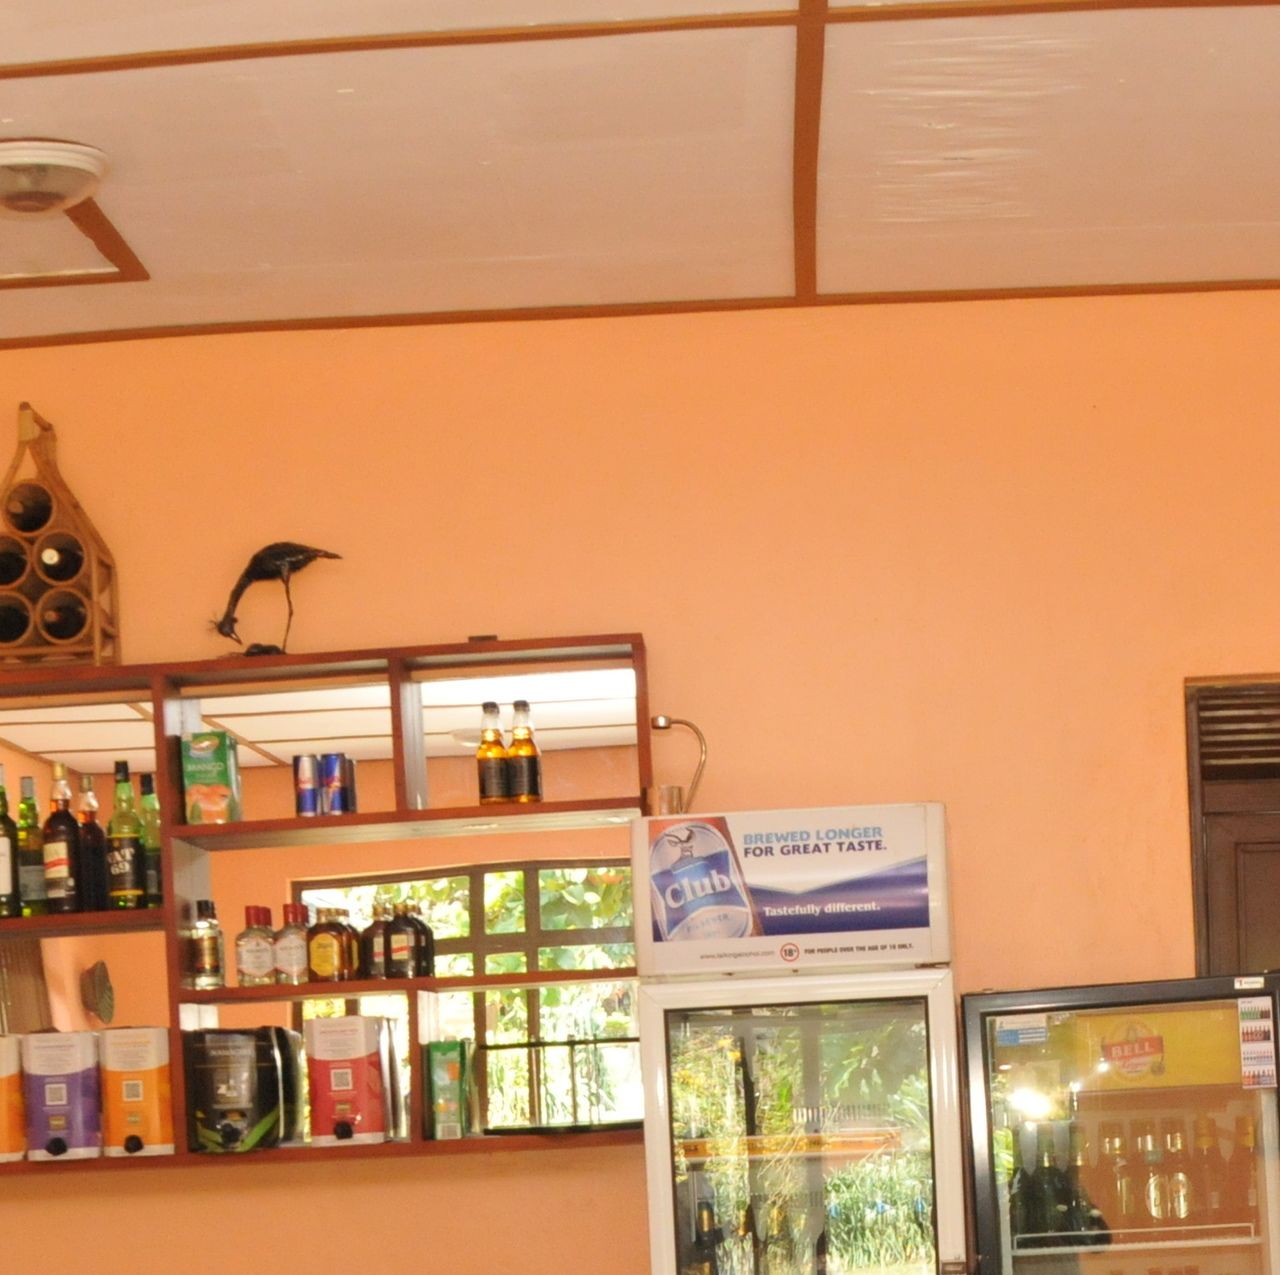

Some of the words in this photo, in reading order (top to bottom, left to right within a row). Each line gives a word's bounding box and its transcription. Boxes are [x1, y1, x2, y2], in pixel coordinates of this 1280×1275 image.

[744, 831, 810, 845] BREWED
[816, 827, 882, 841] LONGER
[744, 846, 774, 858] FOR
[780, 843, 831, 856] GREAT
[836, 840, 887, 852] TASTE.
[111, 861, 130, 875] 69
[665, 870, 731, 908] Club
[763, 904, 820, 916] Tastefully
[824, 901, 880, 914] different.
[1111, 1041, 1154, 1058] BELL
